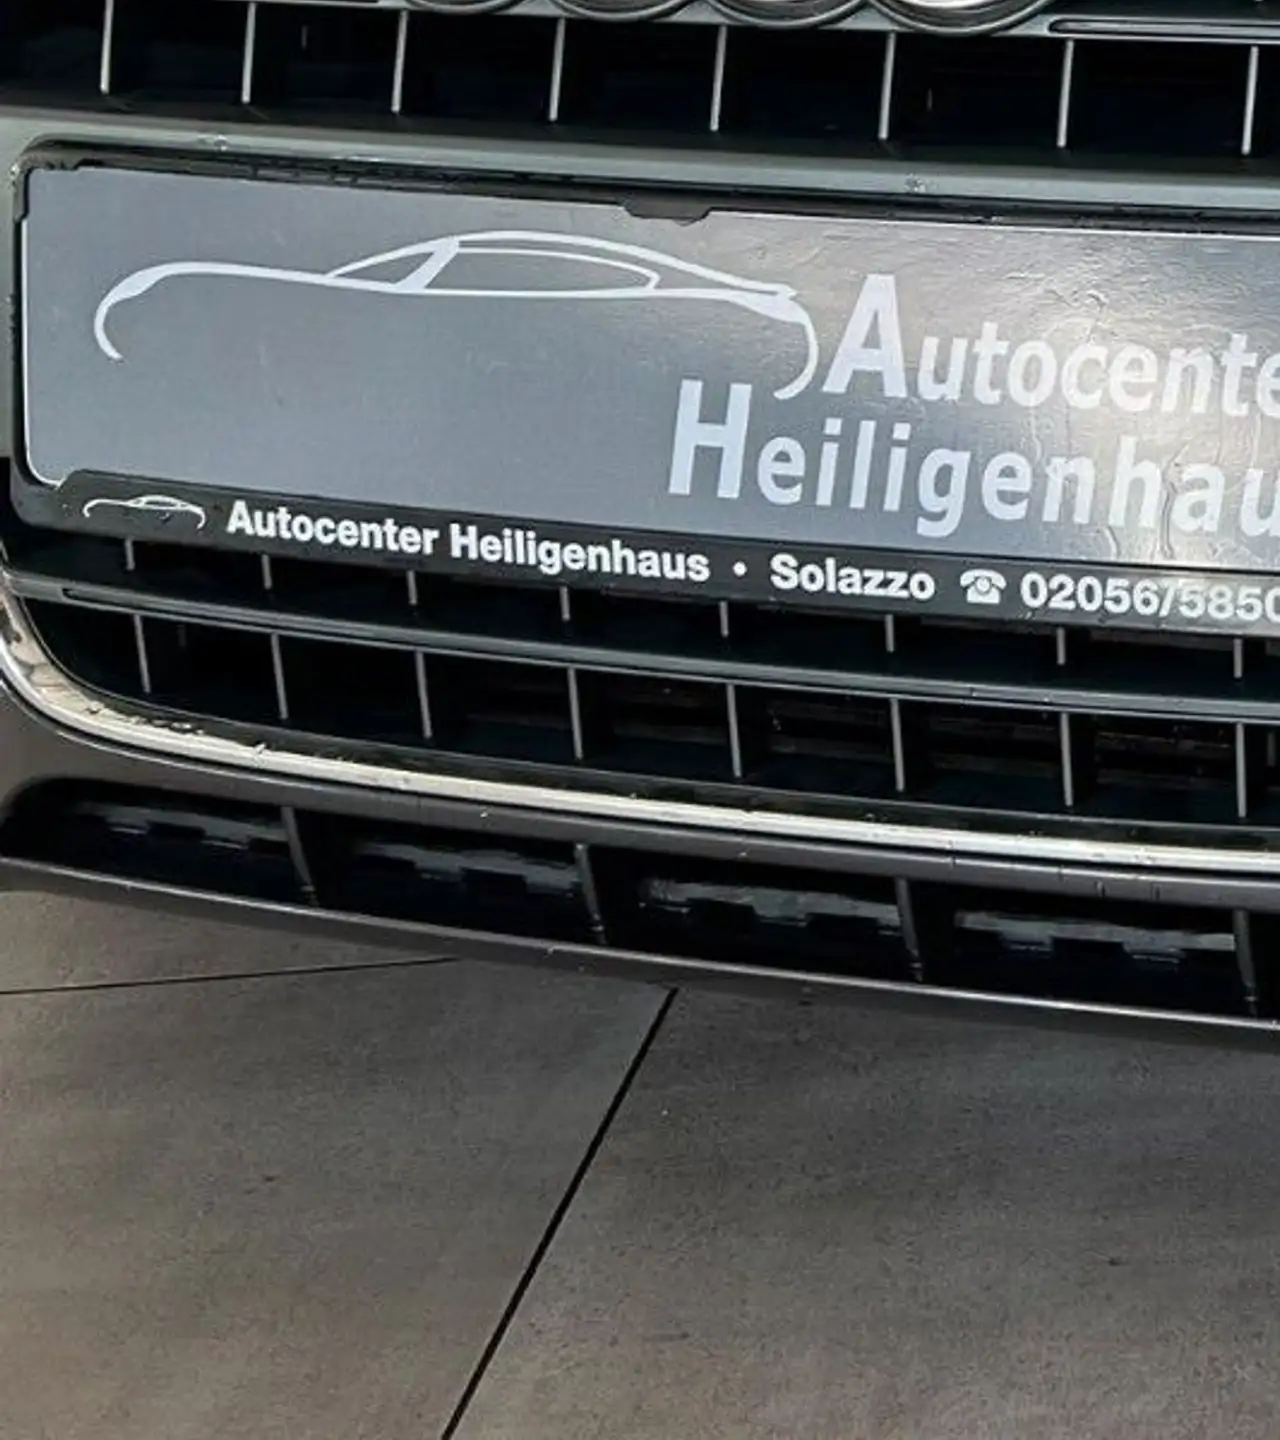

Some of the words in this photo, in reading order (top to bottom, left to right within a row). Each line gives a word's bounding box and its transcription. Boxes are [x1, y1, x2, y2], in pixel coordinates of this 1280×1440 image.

[226, 499, 440, 558] Autocenter
[449, 524, 711, 584] Heiligenhaus
[770, 553, 936, 602] Solazzo
